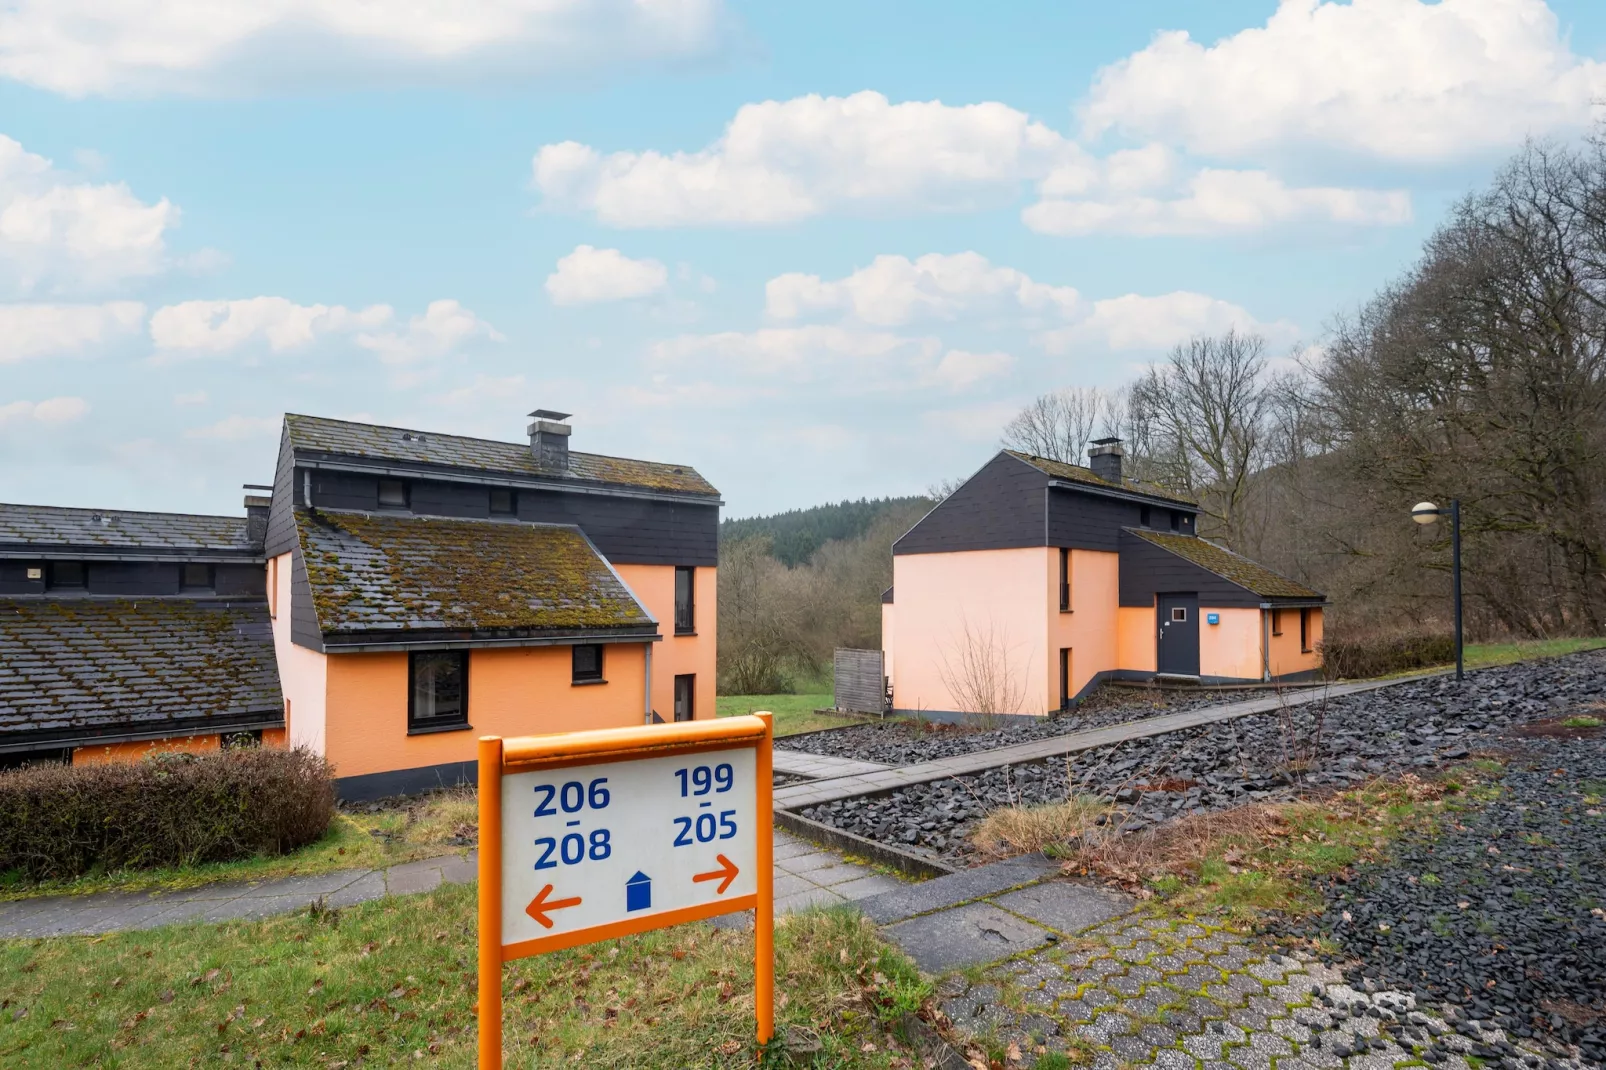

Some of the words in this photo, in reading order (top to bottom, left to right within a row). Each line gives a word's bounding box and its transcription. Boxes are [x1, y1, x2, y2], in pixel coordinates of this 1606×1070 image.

[534, 778, 611, 817] 206
[674, 763, 734, 798] 199
[673, 809, 738, 847] 205
[534, 829, 612, 870] 208
